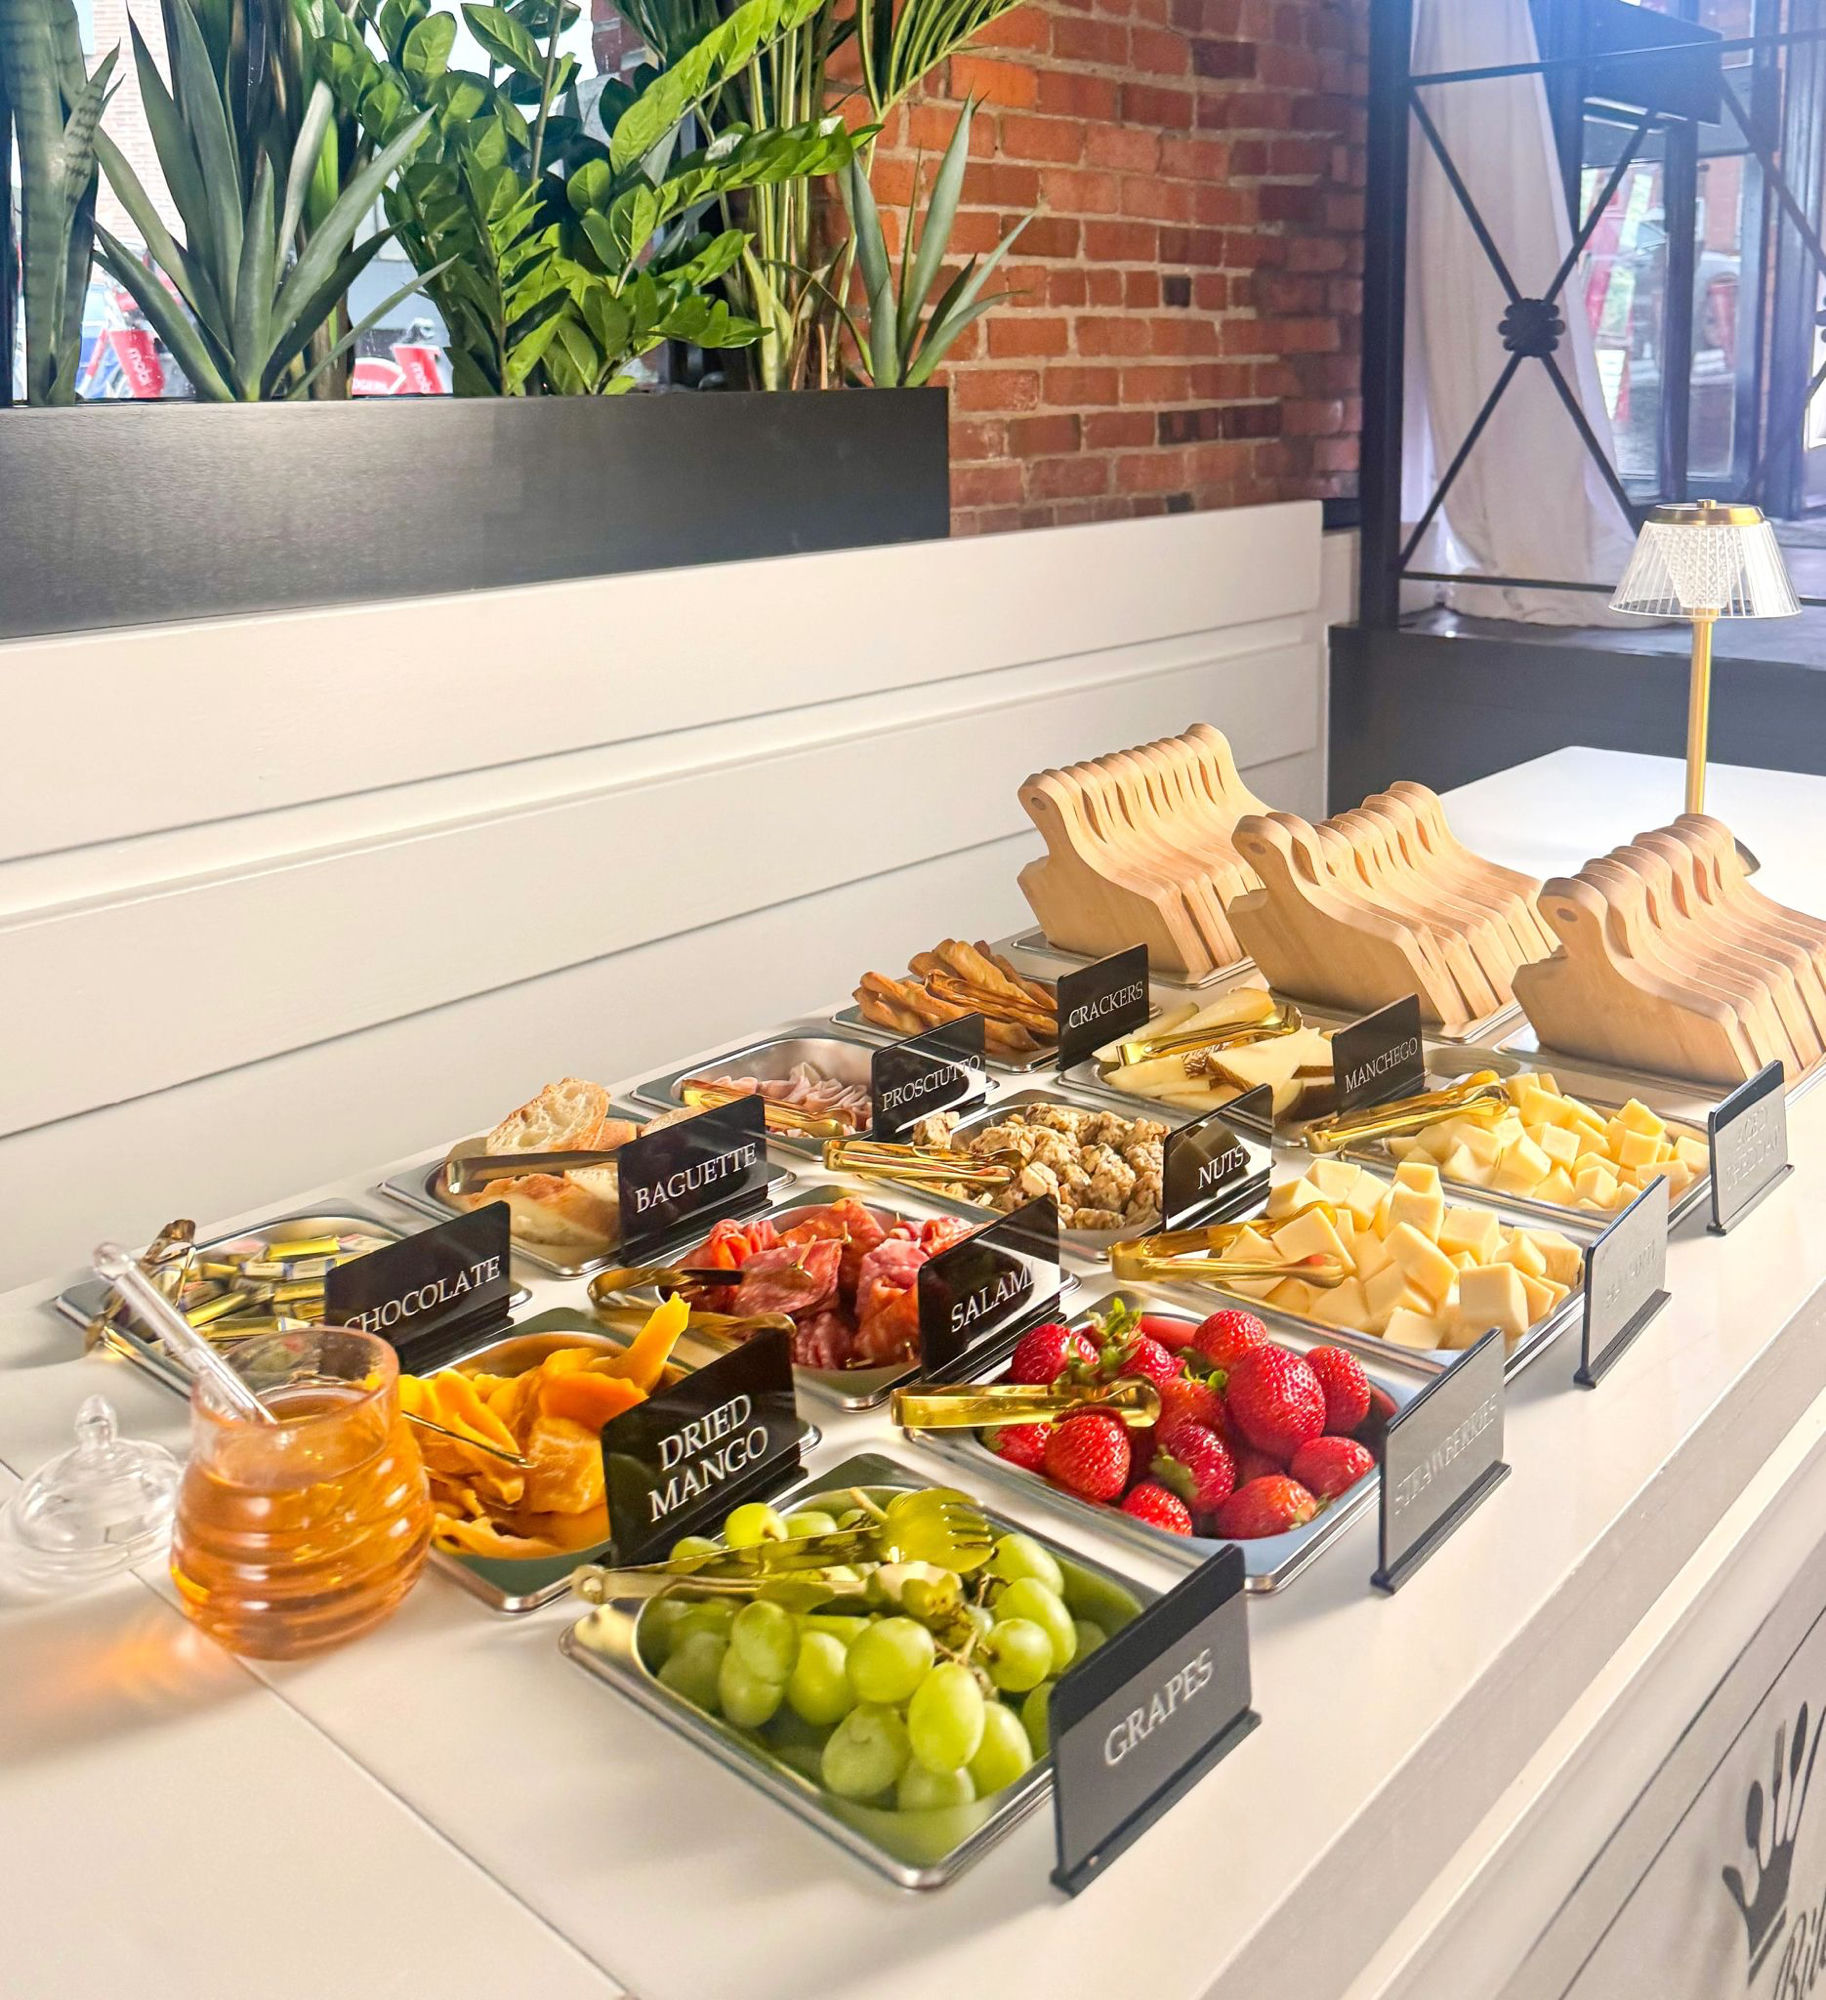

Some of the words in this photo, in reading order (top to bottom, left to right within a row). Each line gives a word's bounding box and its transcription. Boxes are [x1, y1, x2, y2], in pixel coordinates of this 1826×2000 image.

[1069, 981, 1144, 1029] CRACKERS
[882, 1055, 980, 1112] PROSCIUTTO
[1345, 1037, 1418, 1093] MANCHEGO
[635, 1143, 757, 1214] BAGUETTE
[1198, 1144, 1244, 1190] NUTS
[951, 1261, 1037, 1333] SALAM
[657, 1394, 752, 1472] DRIED
[648, 1426, 768, 1522] MANGO
[1104, 1648, 1213, 1766] GRAPES
